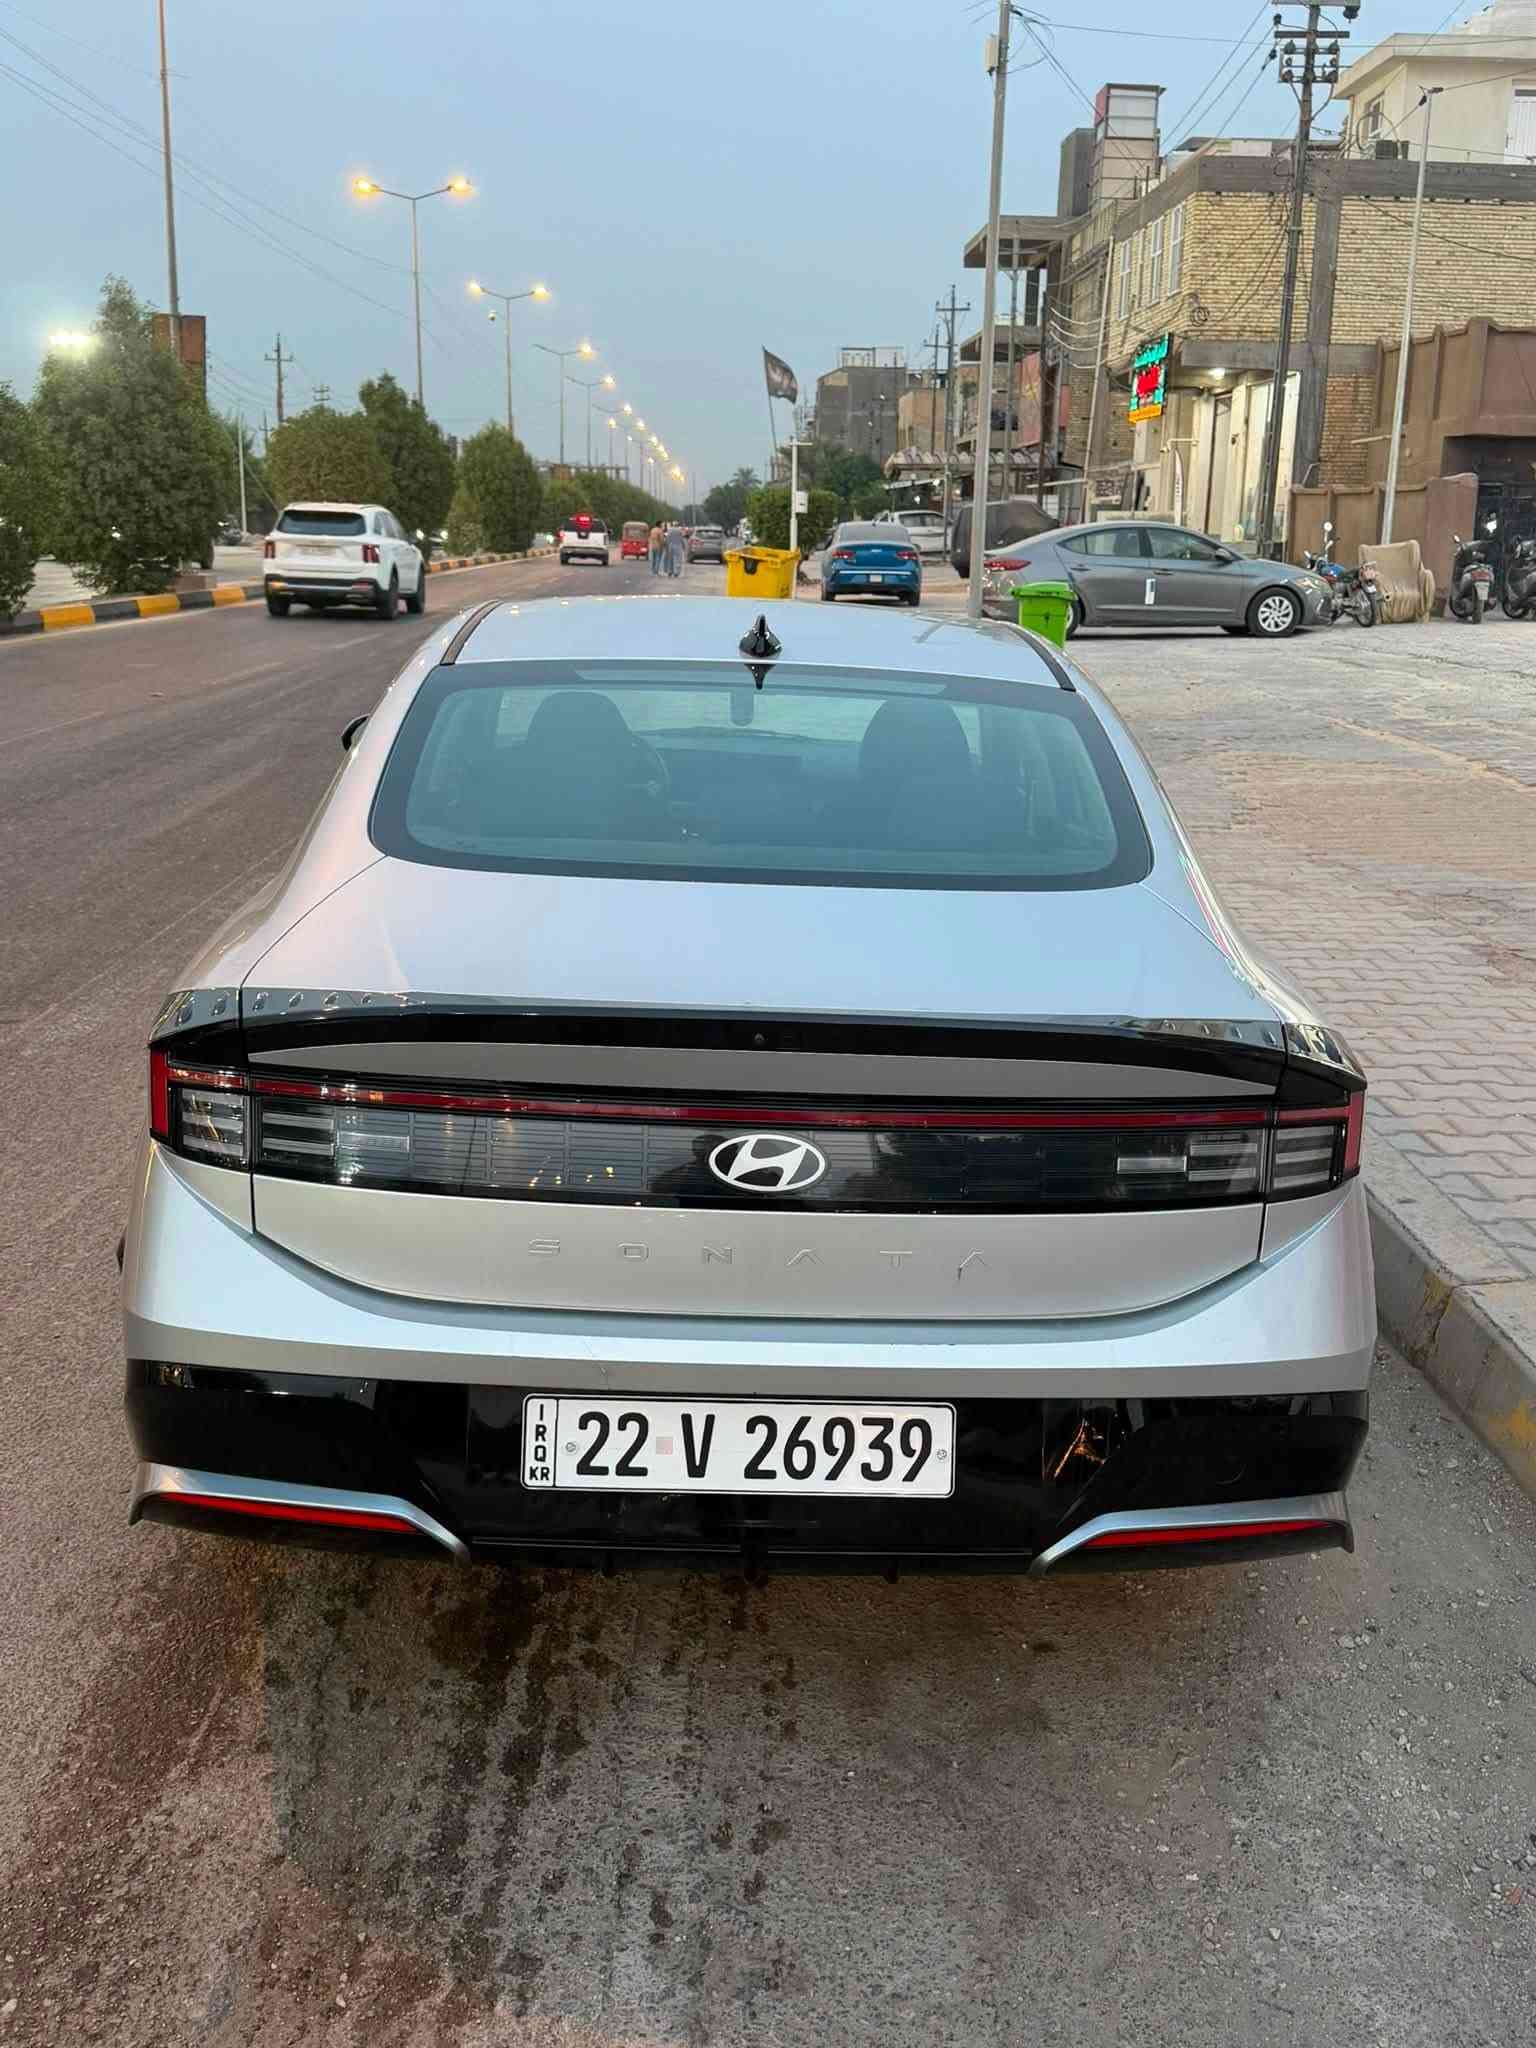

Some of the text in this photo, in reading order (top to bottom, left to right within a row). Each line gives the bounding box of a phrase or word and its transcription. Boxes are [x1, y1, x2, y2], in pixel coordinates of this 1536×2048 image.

[528, 1238, 986, 1281] SONATA
[534, 1403, 548, 1463] IRQ
[576, 1411, 933, 1482] 22 V 26939
[529, 1466, 550, 1481] KR
